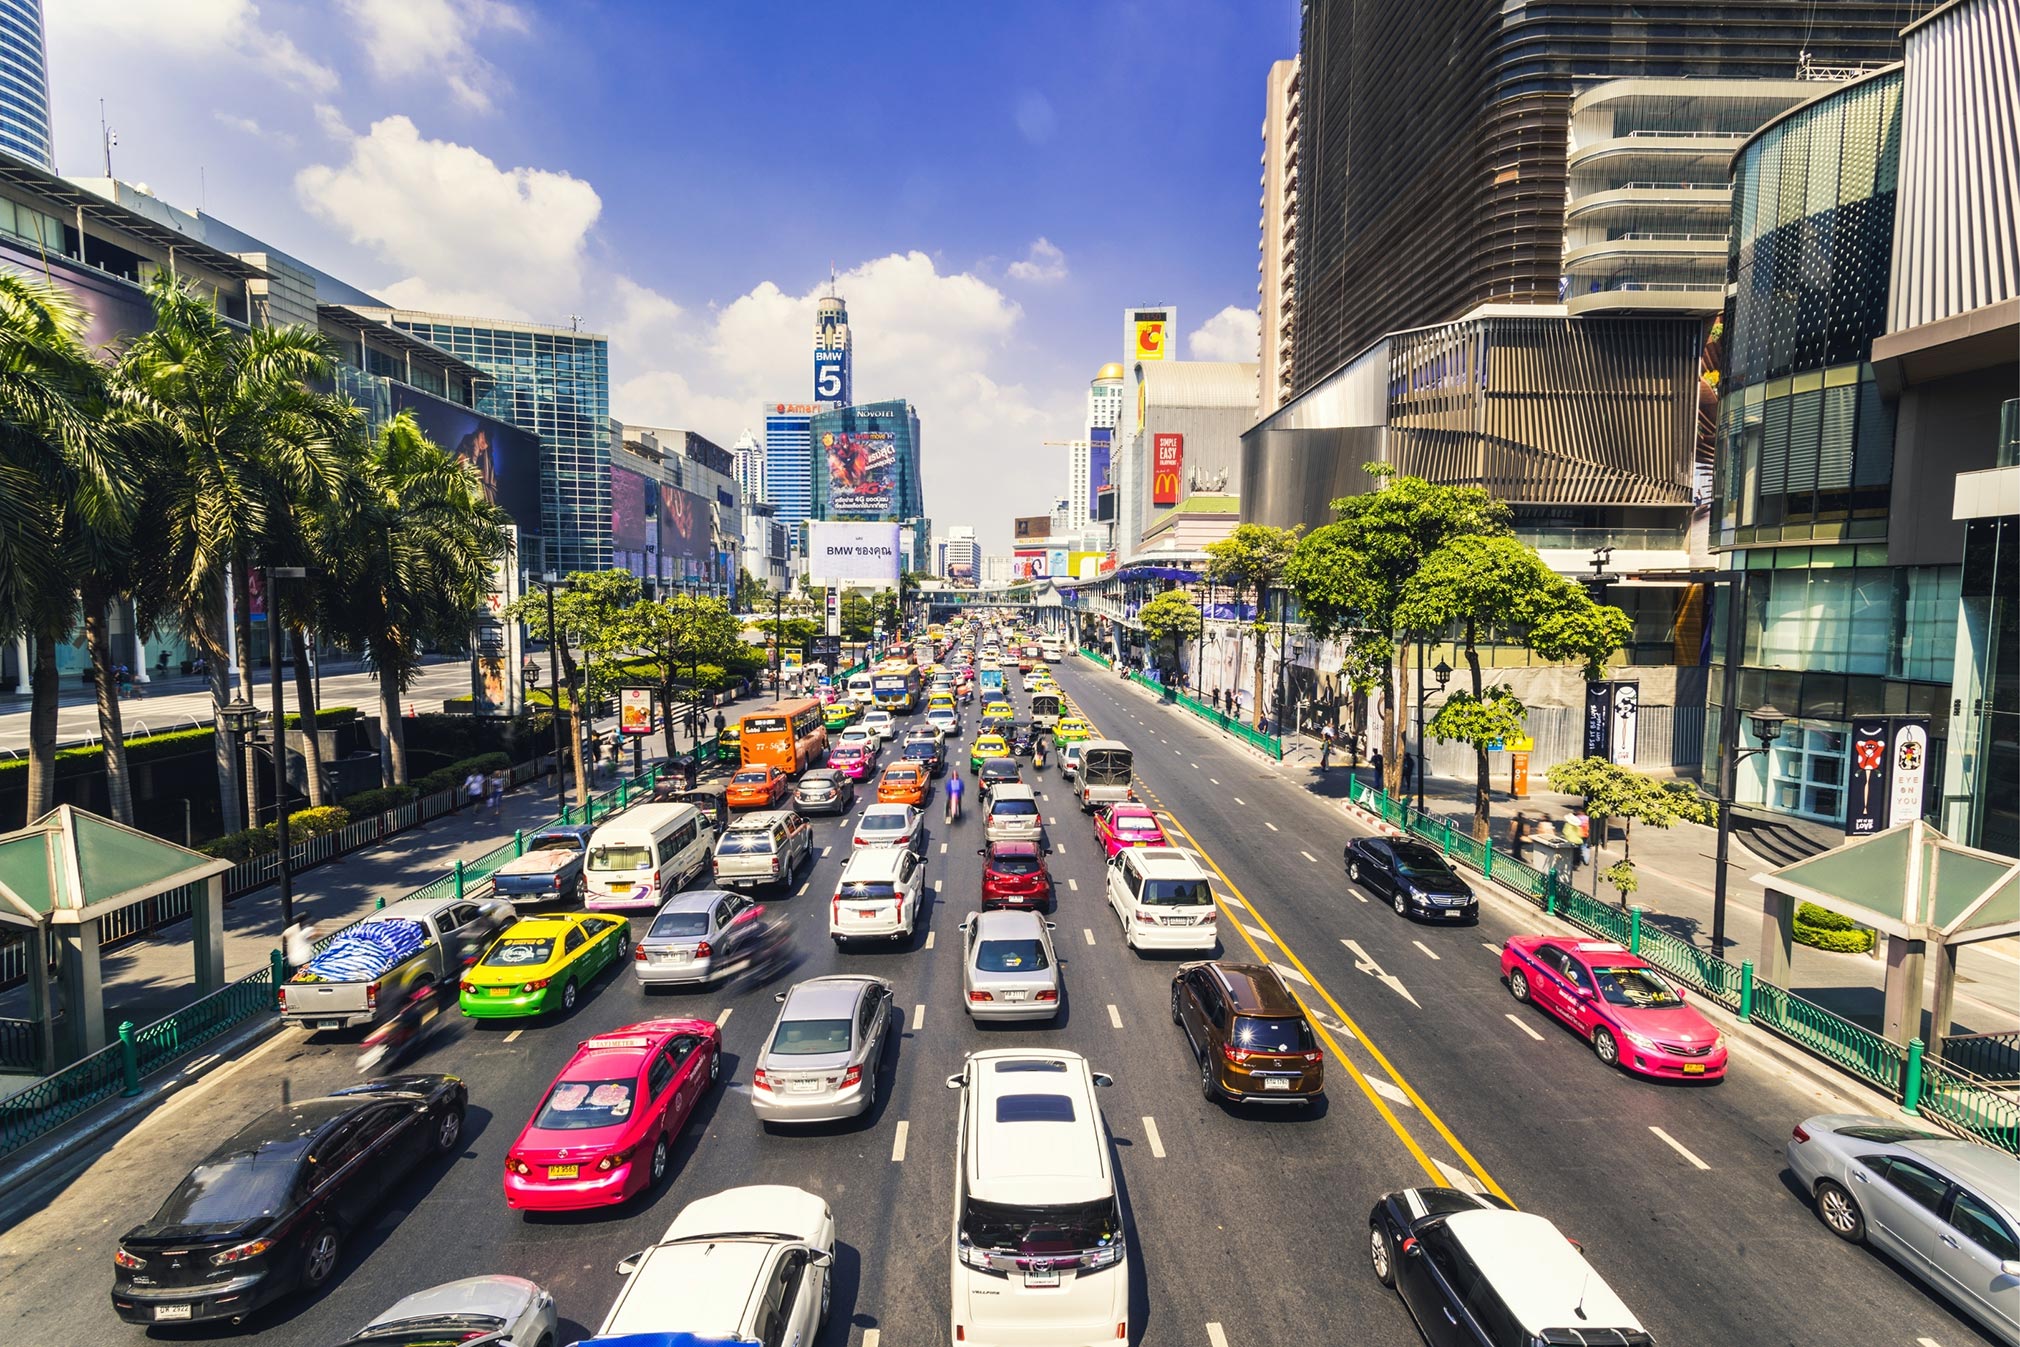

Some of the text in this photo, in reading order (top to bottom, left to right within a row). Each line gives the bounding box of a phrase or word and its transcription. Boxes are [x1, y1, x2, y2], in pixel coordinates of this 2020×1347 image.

[815, 352, 842, 361] BMW
[818, 365, 841, 396] 5
[786, 403, 821, 413] Amari
[857, 410, 894, 418] NOVOTEL
[1159, 438, 1177, 447] SIMPLE
[1159, 447, 1177, 459] EASY
[826, 546, 892, 559] BMW ของคุณ
[1898, 776, 1919, 784] EYE
[1896, 797, 1918, 805] YOU
[1856, 822, 1874, 830] LOVE
